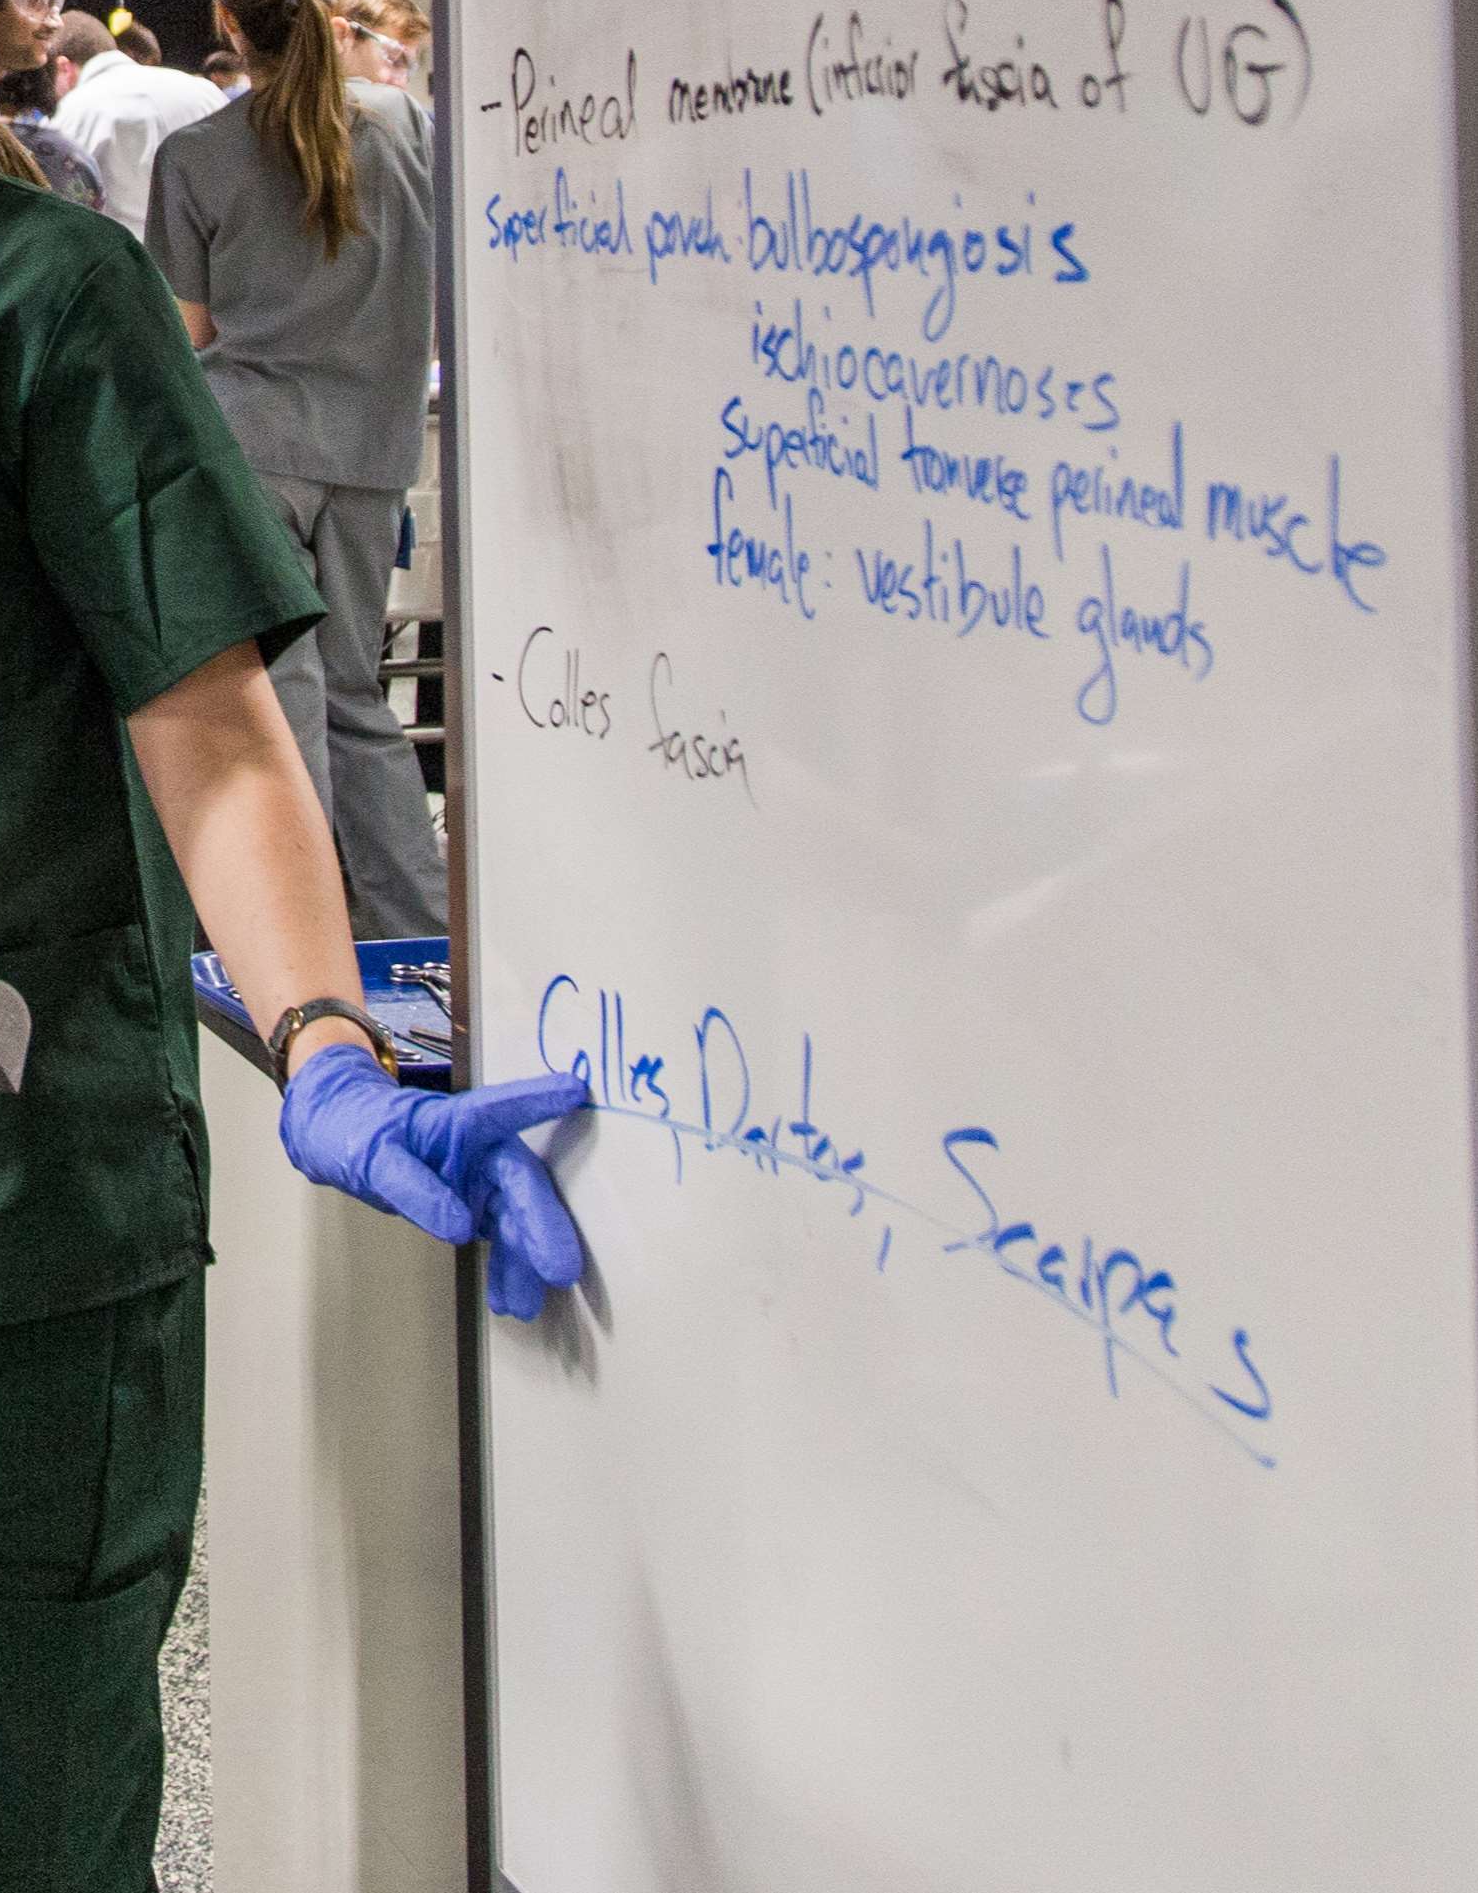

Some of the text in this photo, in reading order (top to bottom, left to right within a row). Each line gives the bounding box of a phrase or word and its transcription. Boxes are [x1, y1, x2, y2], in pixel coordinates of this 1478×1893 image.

[1204, 451, 1389, 614] muscle
[1077, 543, 1216, 726] glands
[647, 651, 759, 807] fascia
